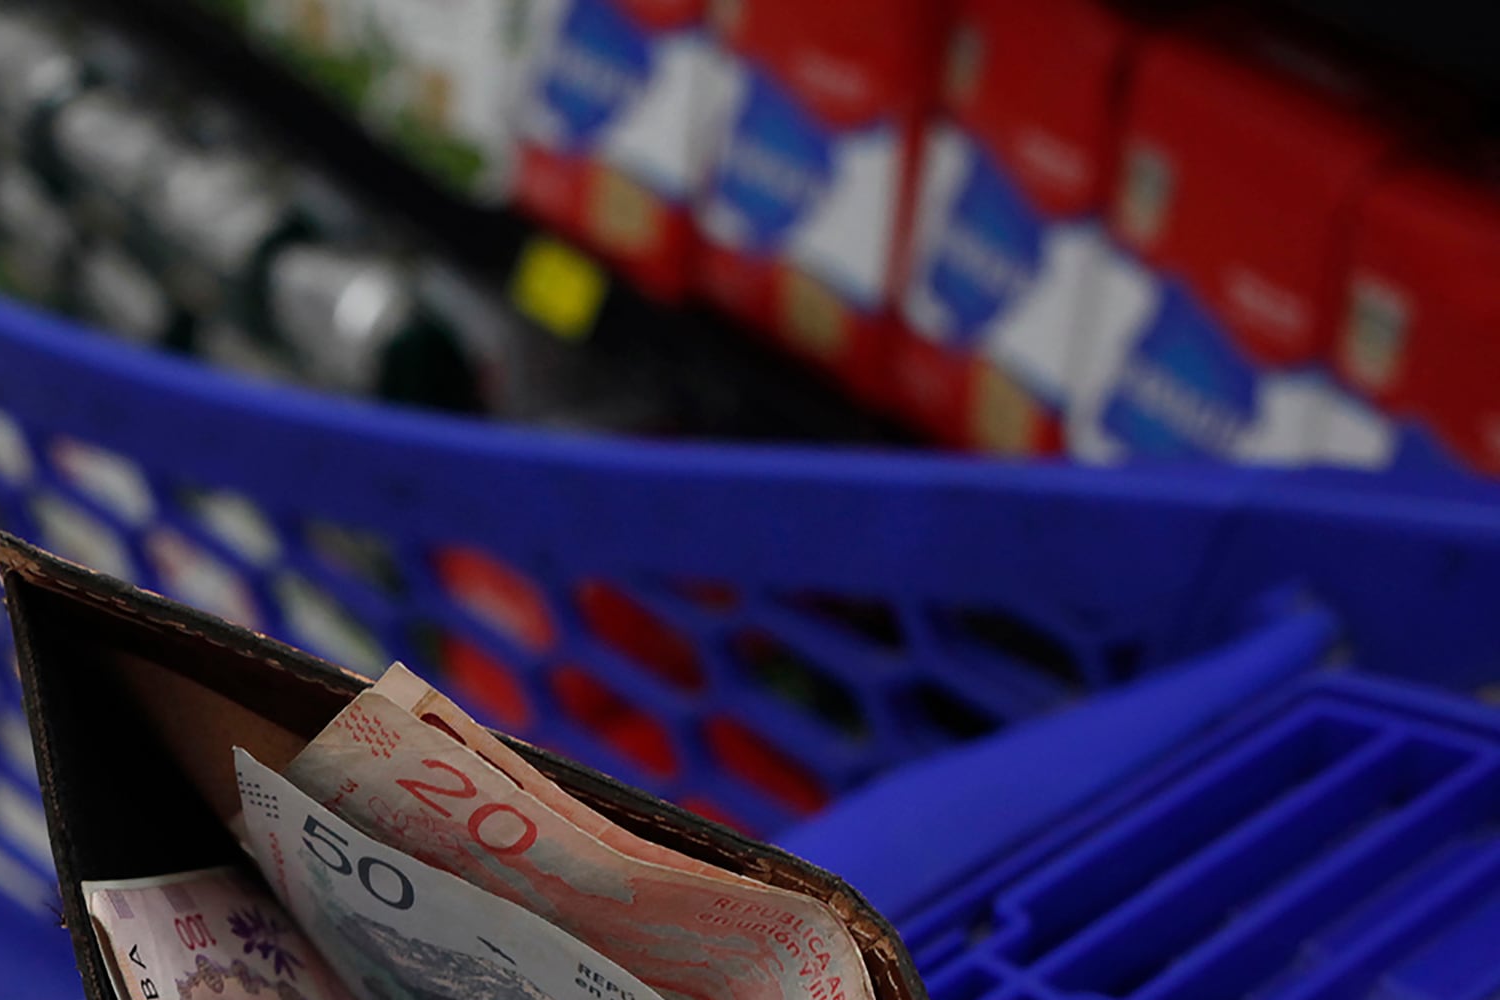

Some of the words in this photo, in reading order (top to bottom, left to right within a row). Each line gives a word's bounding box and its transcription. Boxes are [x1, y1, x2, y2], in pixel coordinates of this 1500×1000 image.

[395, 759, 537, 855] 20
[302, 815, 415, 909] 50
[699, 911, 728, 926] en
[735, 918, 801, 958] unión
[799, 961, 813, 977] y
[575, 977, 602, 998] en
